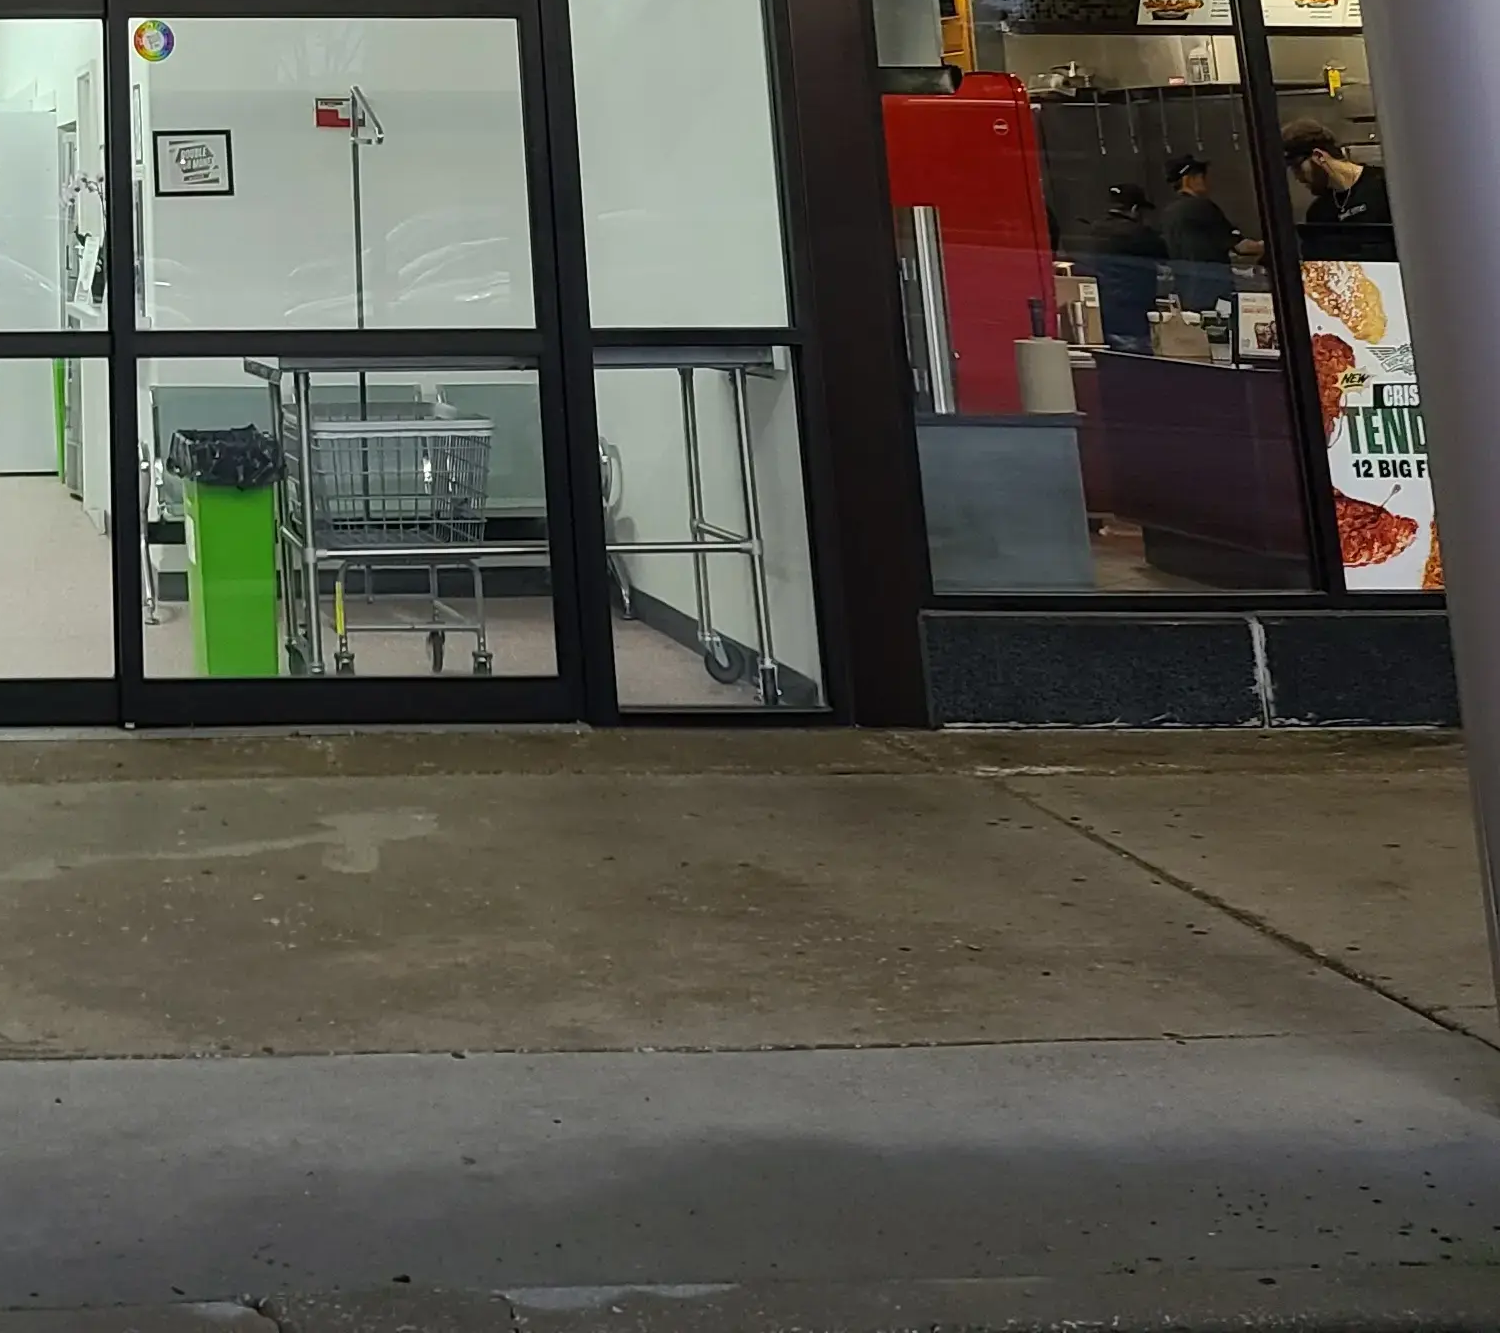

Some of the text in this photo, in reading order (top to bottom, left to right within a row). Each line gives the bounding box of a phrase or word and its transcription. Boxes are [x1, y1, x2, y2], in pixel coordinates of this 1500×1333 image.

[1341, 373, 1370, 385] NEW
[1352, 459, 1374, 478] 12
[1377, 459, 1413, 478] BIG
